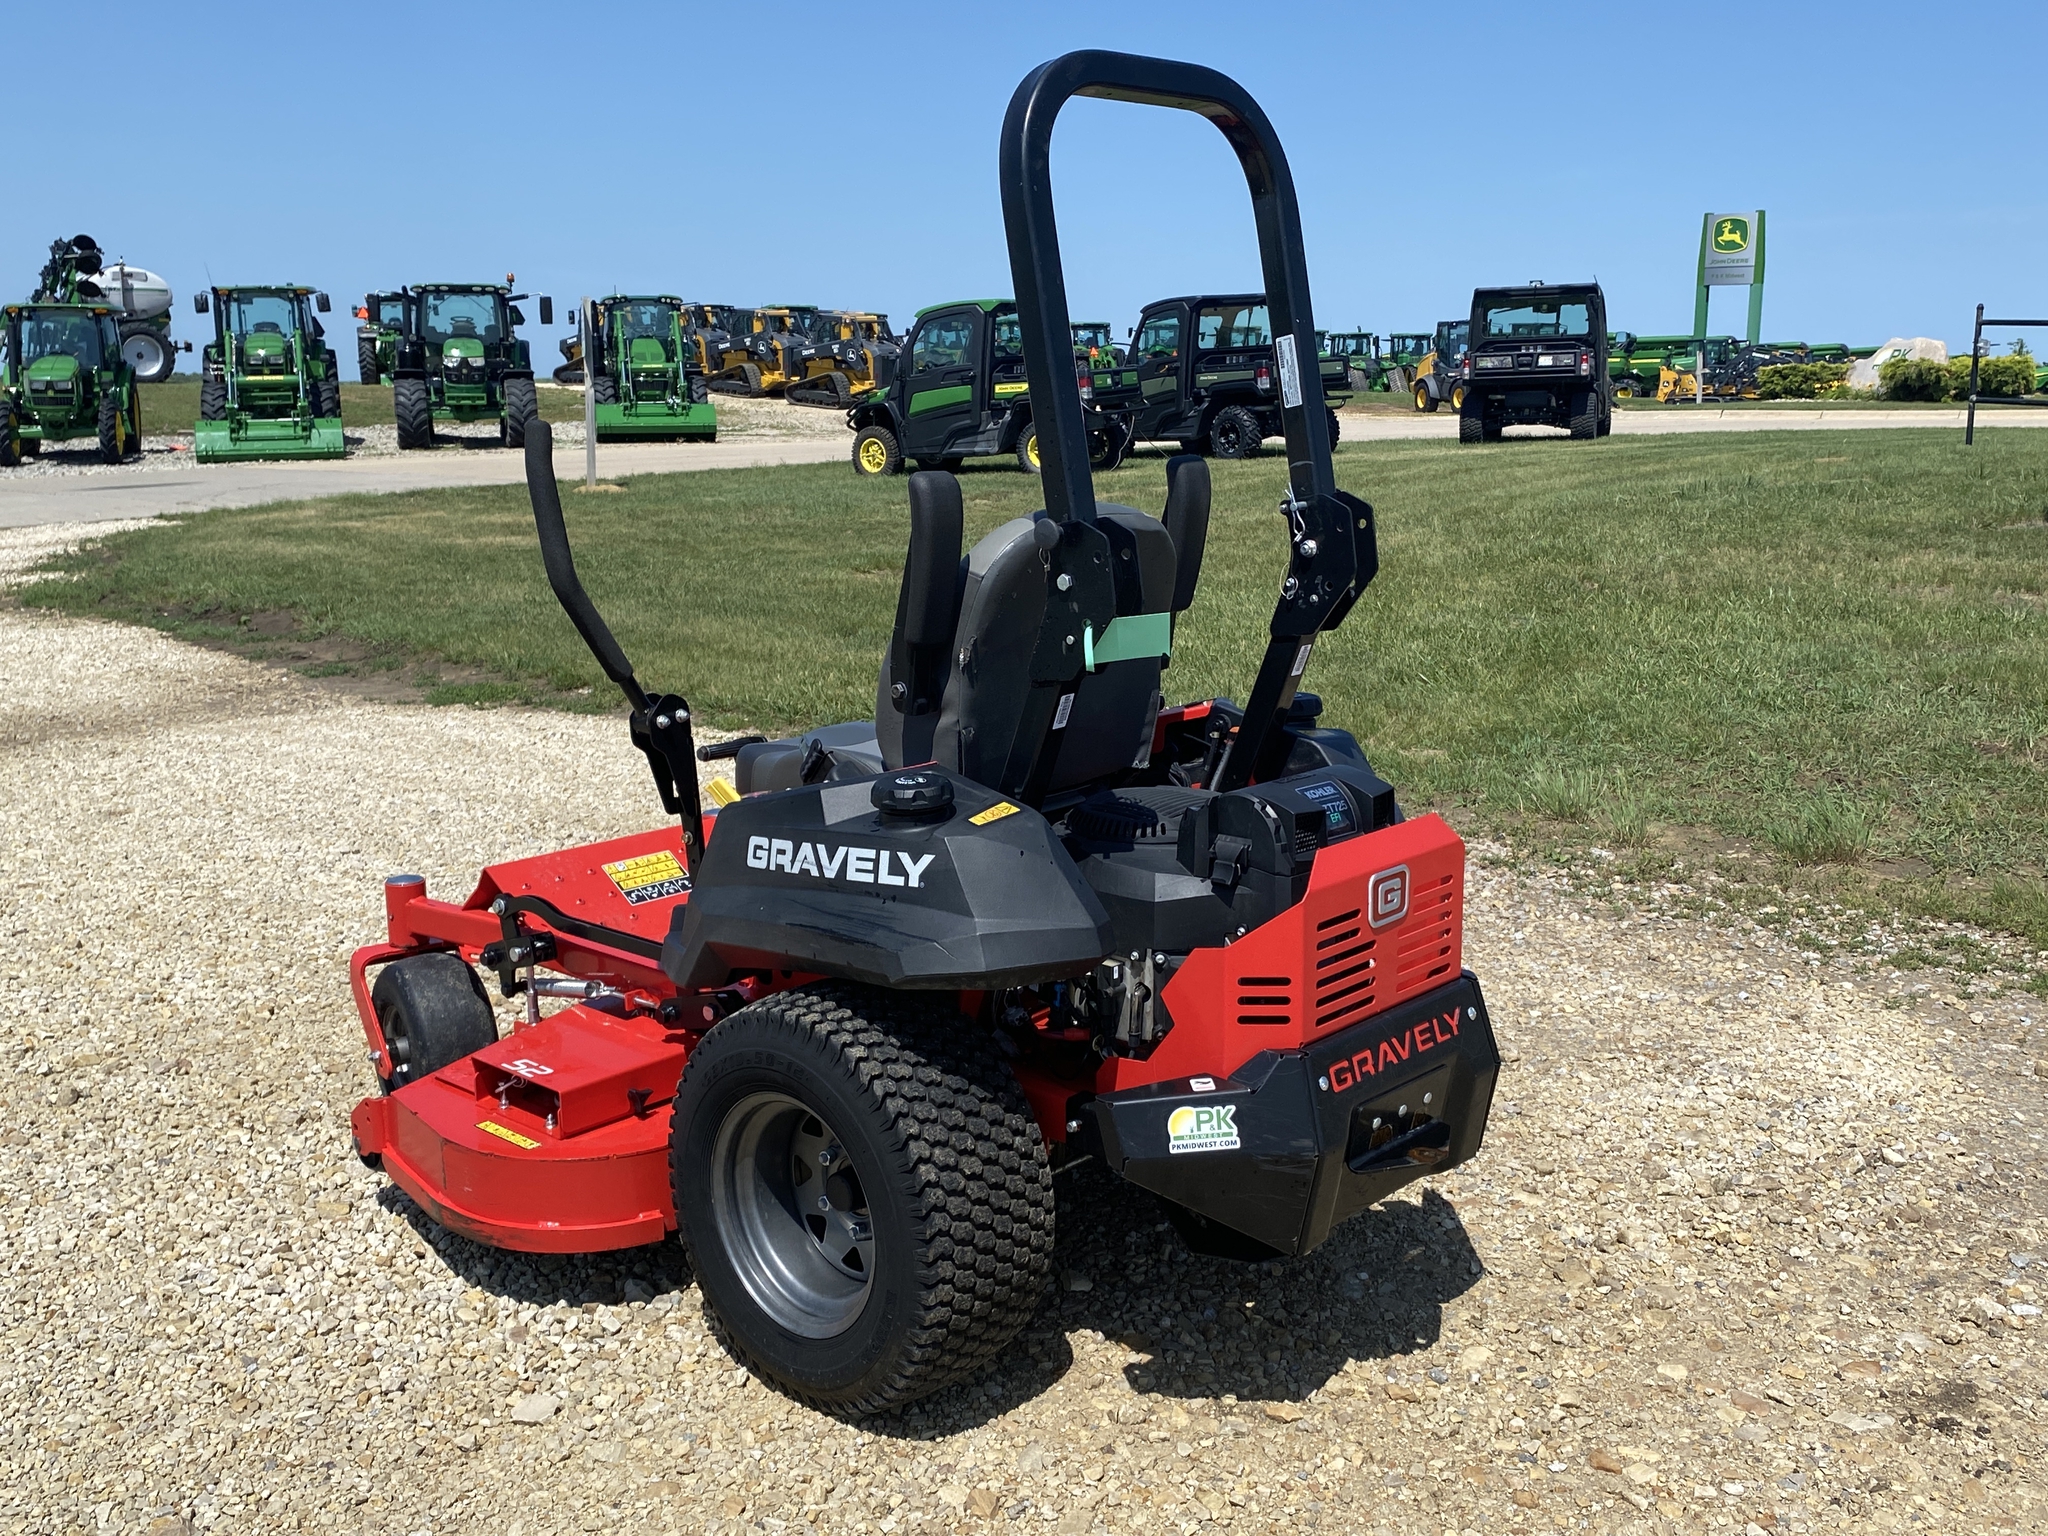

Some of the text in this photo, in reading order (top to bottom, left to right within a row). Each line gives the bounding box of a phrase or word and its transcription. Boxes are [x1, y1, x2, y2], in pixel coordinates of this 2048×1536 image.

[1304, 786, 1339, 800] KOHLER
[1329, 812, 1342, 824] EFI
[746, 835, 936, 888] GRAVELY
[1328, 1005, 1461, 1093] GRAVELY
[501, 1058, 554, 1078] 52
[1171, 1139, 1238, 1151] PKMIDWEST.COM
